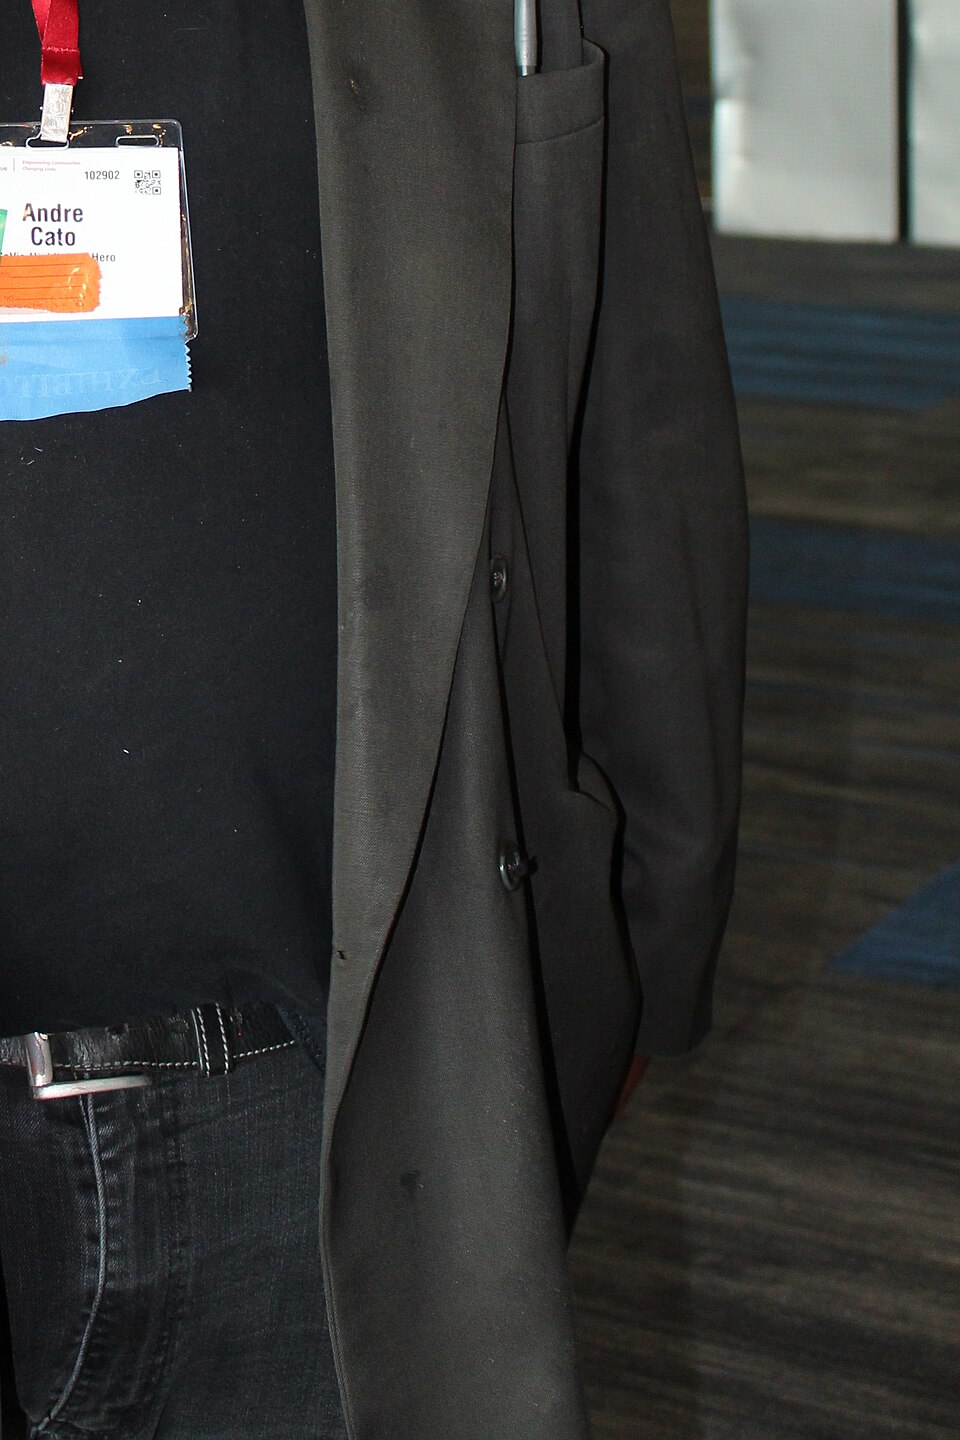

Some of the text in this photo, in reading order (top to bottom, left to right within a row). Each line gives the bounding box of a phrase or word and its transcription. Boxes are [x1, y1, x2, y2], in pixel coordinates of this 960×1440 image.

[84, 170, 120, 180] 102902
[22, 203, 84, 223] Andre
[31, 226, 76, 247] Cato
[91, 252, 116, 262] Hero
